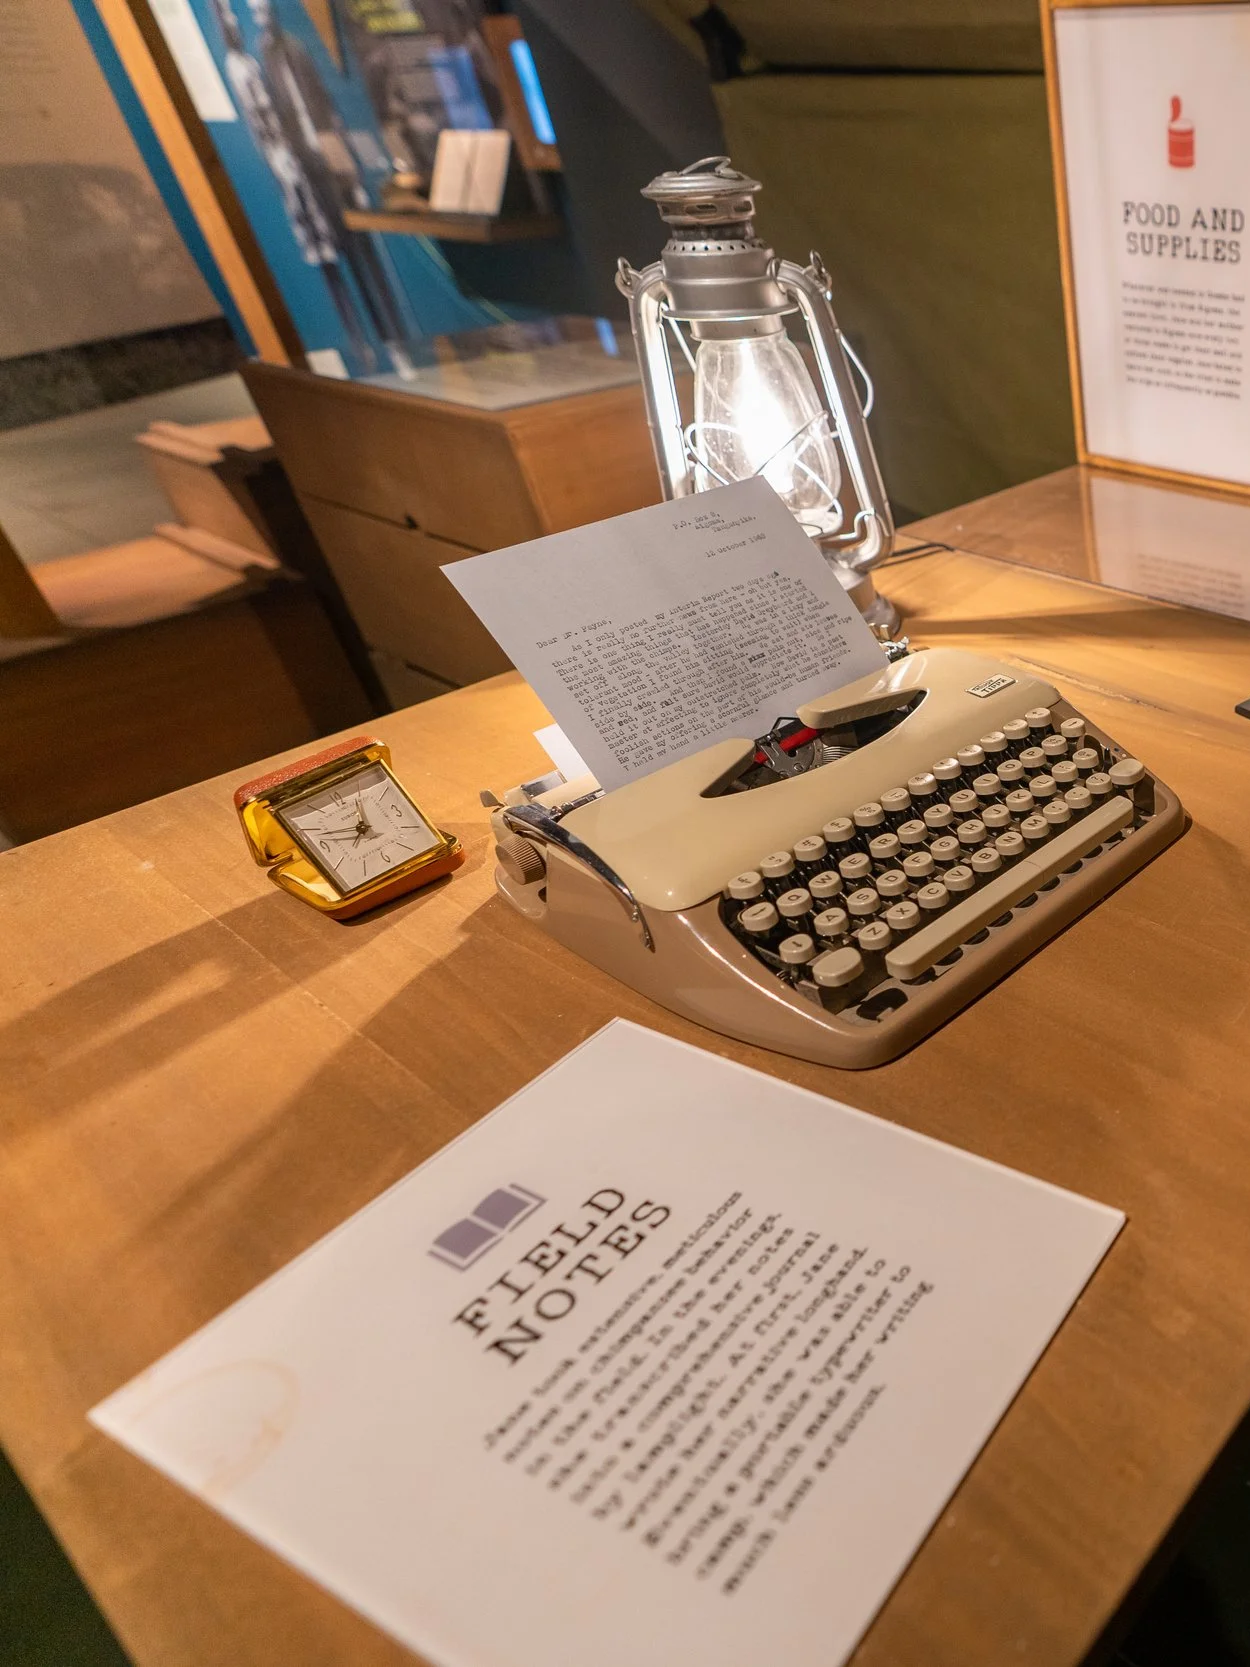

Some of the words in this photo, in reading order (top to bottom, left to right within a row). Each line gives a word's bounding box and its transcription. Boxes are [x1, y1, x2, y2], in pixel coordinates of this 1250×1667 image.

[1122, 201, 1181, 228] FOOD
[1191, 207, 1245, 233] AND
[1126, 231, 1241, 265] SUPPLIES
[550, 654, 579, 668] there
[580, 648, 593, 657] is
[594, 636, 627, 652] really
[628, 631, 640, 639] no
[719, 594, 738, 604] here
[758, 581, 773, 590] but
[569, 642, 583, 652] As
[593, 630, 617, 643] only
[617, 618, 649, 634] posted
[654, 612, 667, 621] my
[701, 588, 730, 603] Report
[730, 583, 745, 591] two
[535, 636, 560, 648] Dear
[580, 617, 613, 633] Payne,
[555, 661, 584, 676] There
[586, 656, 599, 664] is
[601, 650, 618, 659] one
[620, 638, 646, 652] thing
[655, 622, 685, 638] really
[707, 606, 727, 618] tell
[727, 601, 743, 611] you
[565, 671, 605, 692] working
[605, 663, 628, 675] with
[630, 655, 646, 665] the
[647, 642, 682, 660] chimps.
[617, 754, 629, 764] He
[716, 699, 751, 720] scornful
[795, 668, 820, 683] turned
[612, 736, 650, 758] foolish
[651, 721, 685, 741] actions
[686, 715, 699, 724] on
[715, 699, 735, 712] part
[669, 737, 690, 751] hand
[699, 719, 727, 737] little
[329, 792, 347, 807] 12
[956, 793, 970, 801] U
[1013, 793, 1026, 801] K
[391, 804, 403, 818] 3
[905, 824, 918, 832] T
[964, 824, 979, 832] H
[1027, 819, 1042, 827] M
[320, 840, 331, 853] 9
[878, 838, 892, 846] R
[1003, 836, 1017, 844] N
[380, 851, 391, 863] 6
[848, 858, 862, 867] E
[912, 856, 924, 865] F
[979, 852, 992, 860] B
[816, 875, 833, 886] W
[951, 870, 966, 878] V
[788, 893, 802, 903] Q
[857, 893, 870, 901] S
[928, 888, 940, 896] C
[826, 914, 839, 923] A
[896, 907, 911, 916] X
[867, 926, 882, 936] Z
[654, 1189, 747, 1270] meticulous
[681, 1206, 758, 1275] behavior
[452, 1188, 625, 1338] FIELD
[888, 1263, 915, 1283] to
[483, 1200, 671, 1368] NOTES
[722, 1338, 757, 1368] At
[750, 1286, 803, 1335] first,
[794, 1241, 843, 1285] Jane
[547, 1406, 595, 1448] the
[644, 1321, 676, 1347] In
[669, 1287, 710, 1320] the
[702, 1210, 787, 1287] evenings,
[757, 1366, 798, 1404] she
[795, 1324, 834, 1362] was
[825, 1280, 869, 1322] able
[862, 1256, 890, 1278] to
[805, 1285, 902, 1388] typewriter
[616, 1436, 638, 1453] a
[630, 1292, 772, 1436] comprehensive
[754, 1230, 827, 1295] journal
[542, 1447, 591, 1492] she
[587, 1316, 715, 1443] transcribed
[707, 1278, 749, 1313] her
[743, 1226, 798, 1275] notes
[676, 1419, 719, 1461] her
[712, 1325, 801, 1420] narrative
[792, 1244, 874, 1325] longhand.
[744, 1441, 809, 1510] which
[797, 1385, 851, 1439] made
[840, 1348, 879, 1384] her
[870, 1279, 936, 1347] writing
[729, 1387, 820, 1482] portable
[721, 1480, 742, 1498] a
